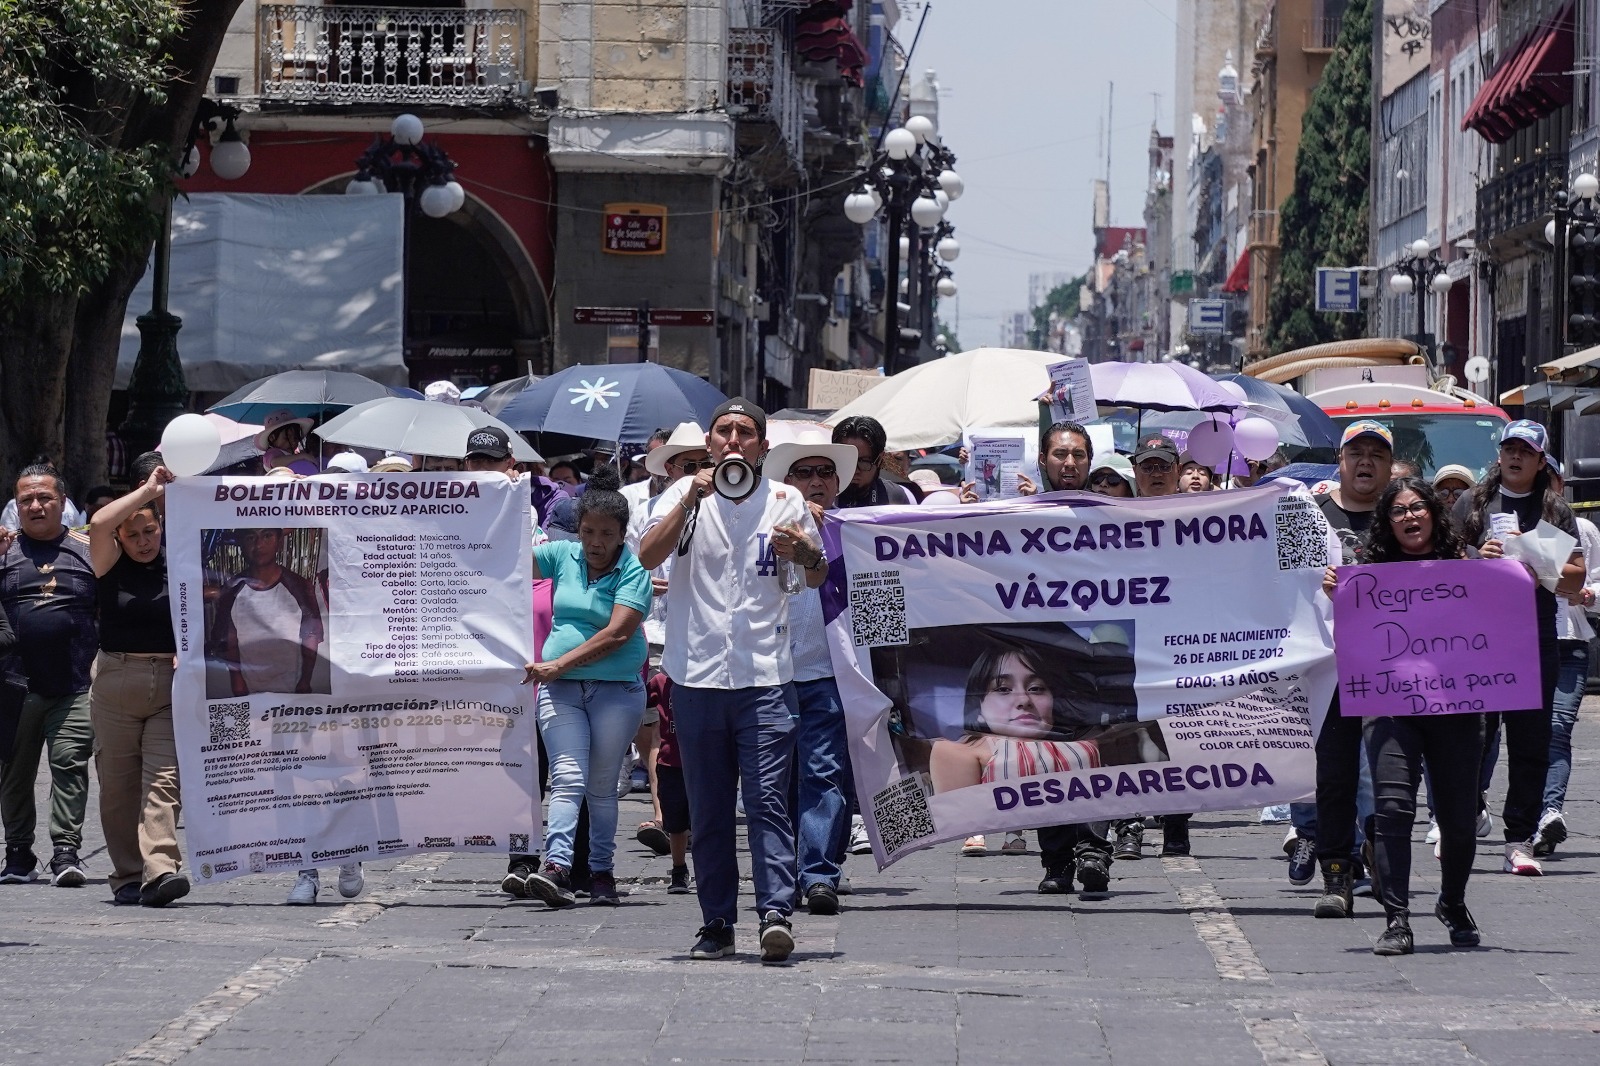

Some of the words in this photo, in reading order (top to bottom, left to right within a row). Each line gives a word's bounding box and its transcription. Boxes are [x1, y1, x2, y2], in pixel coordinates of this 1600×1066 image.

[608, 229, 616, 238] 16
[617, 229, 625, 238] de
[1324, 272, 1351, 303] E
[428, 348, 469, 356] PROHIBIDO
[214, 480, 311, 501] BOLETÍN
[318, 484, 348, 501] DE
[355, 478, 480, 499] BÚSQUEDA
[237, 506, 281, 516] MARIO
[285, 506, 358, 516] HUMBERTO
[362, 506, 397, 515] CRUZ
[401, 504, 469, 515] APARICIO.
[874, 528, 1012, 562] DANNA
[1020, 519, 1166, 555] XCARET
[1174, 513, 1268, 546] MORA
[468, 543, 492, 551] Aprox.
[756, 533, 777, 576] LA
[363, 561, 416, 570] Complexión:
[420, 561, 457, 570] Delgada.
[399, 570, 416, 579] piel:
[995, 572, 1171, 611] VÁZQUEZ
[1345, 573, 1468, 612] Regresa
[422, 624, 453, 632] Amplia.
[392, 634, 417, 642] Cejas:
[445, 632, 485, 641] pobladas.
[1164, 634, 1200, 646] FECHA
[1203, 633, 1217, 644] DE
[1220, 628, 1291, 642] NACIMIENTO:
[1373, 622, 1488, 662] Danna
[398, 642, 418, 651] ojos:
[398, 651, 418, 660] ojos:
[1174, 654, 1187, 664] 26
[1190, 653, 1204, 663] DE
[1207, 651, 1239, 662] ABRIL
[1242, 649, 1256, 660] DE
[1258, 648, 1283, 659] 2012
[1176, 675, 1216, 688] EDAD:
[1220, 674, 1235, 686] 13
[1238, 669, 1279, 685] AÑOS
[1464, 672, 1517, 692] para
[1404, 694, 1484, 714] Danna
[261, 705, 323, 721] ¿Tienes
[326, 700, 438, 716] información?
[441, 700, 524, 716] ¡Llámanos!
[394, 718, 403, 727] o
[406, 714, 515, 729] 2226-82-1258
[1206, 719, 1230, 728] CAFÉ
[1176, 732, 1201, 740] OJOS
[1204, 729, 1254, 739] GRANDES,
[201, 742, 230, 752] BUZÓN
[357, 742, 398, 751] VESTIMENTA
[1200, 742, 1233, 750] COLOR
[1236, 738, 1259, 749] CAFÉ
[1262, 740, 1313, 749] OBSCURO.
[217, 754, 246, 763] VISTO(A)
[205, 770, 238, 779] Francisco
[257, 764, 292, 772] municipio
[993, 762, 1275, 811] DESAPARECIDA
[207, 793, 227, 802] SEÑAS
[228, 789, 274, 800] PARTICULARES
[222, 841, 268, 853] ELABORACIÓN:
[312, 845, 369, 861] Gobernación
[266, 851, 302, 861] PUEBLA
